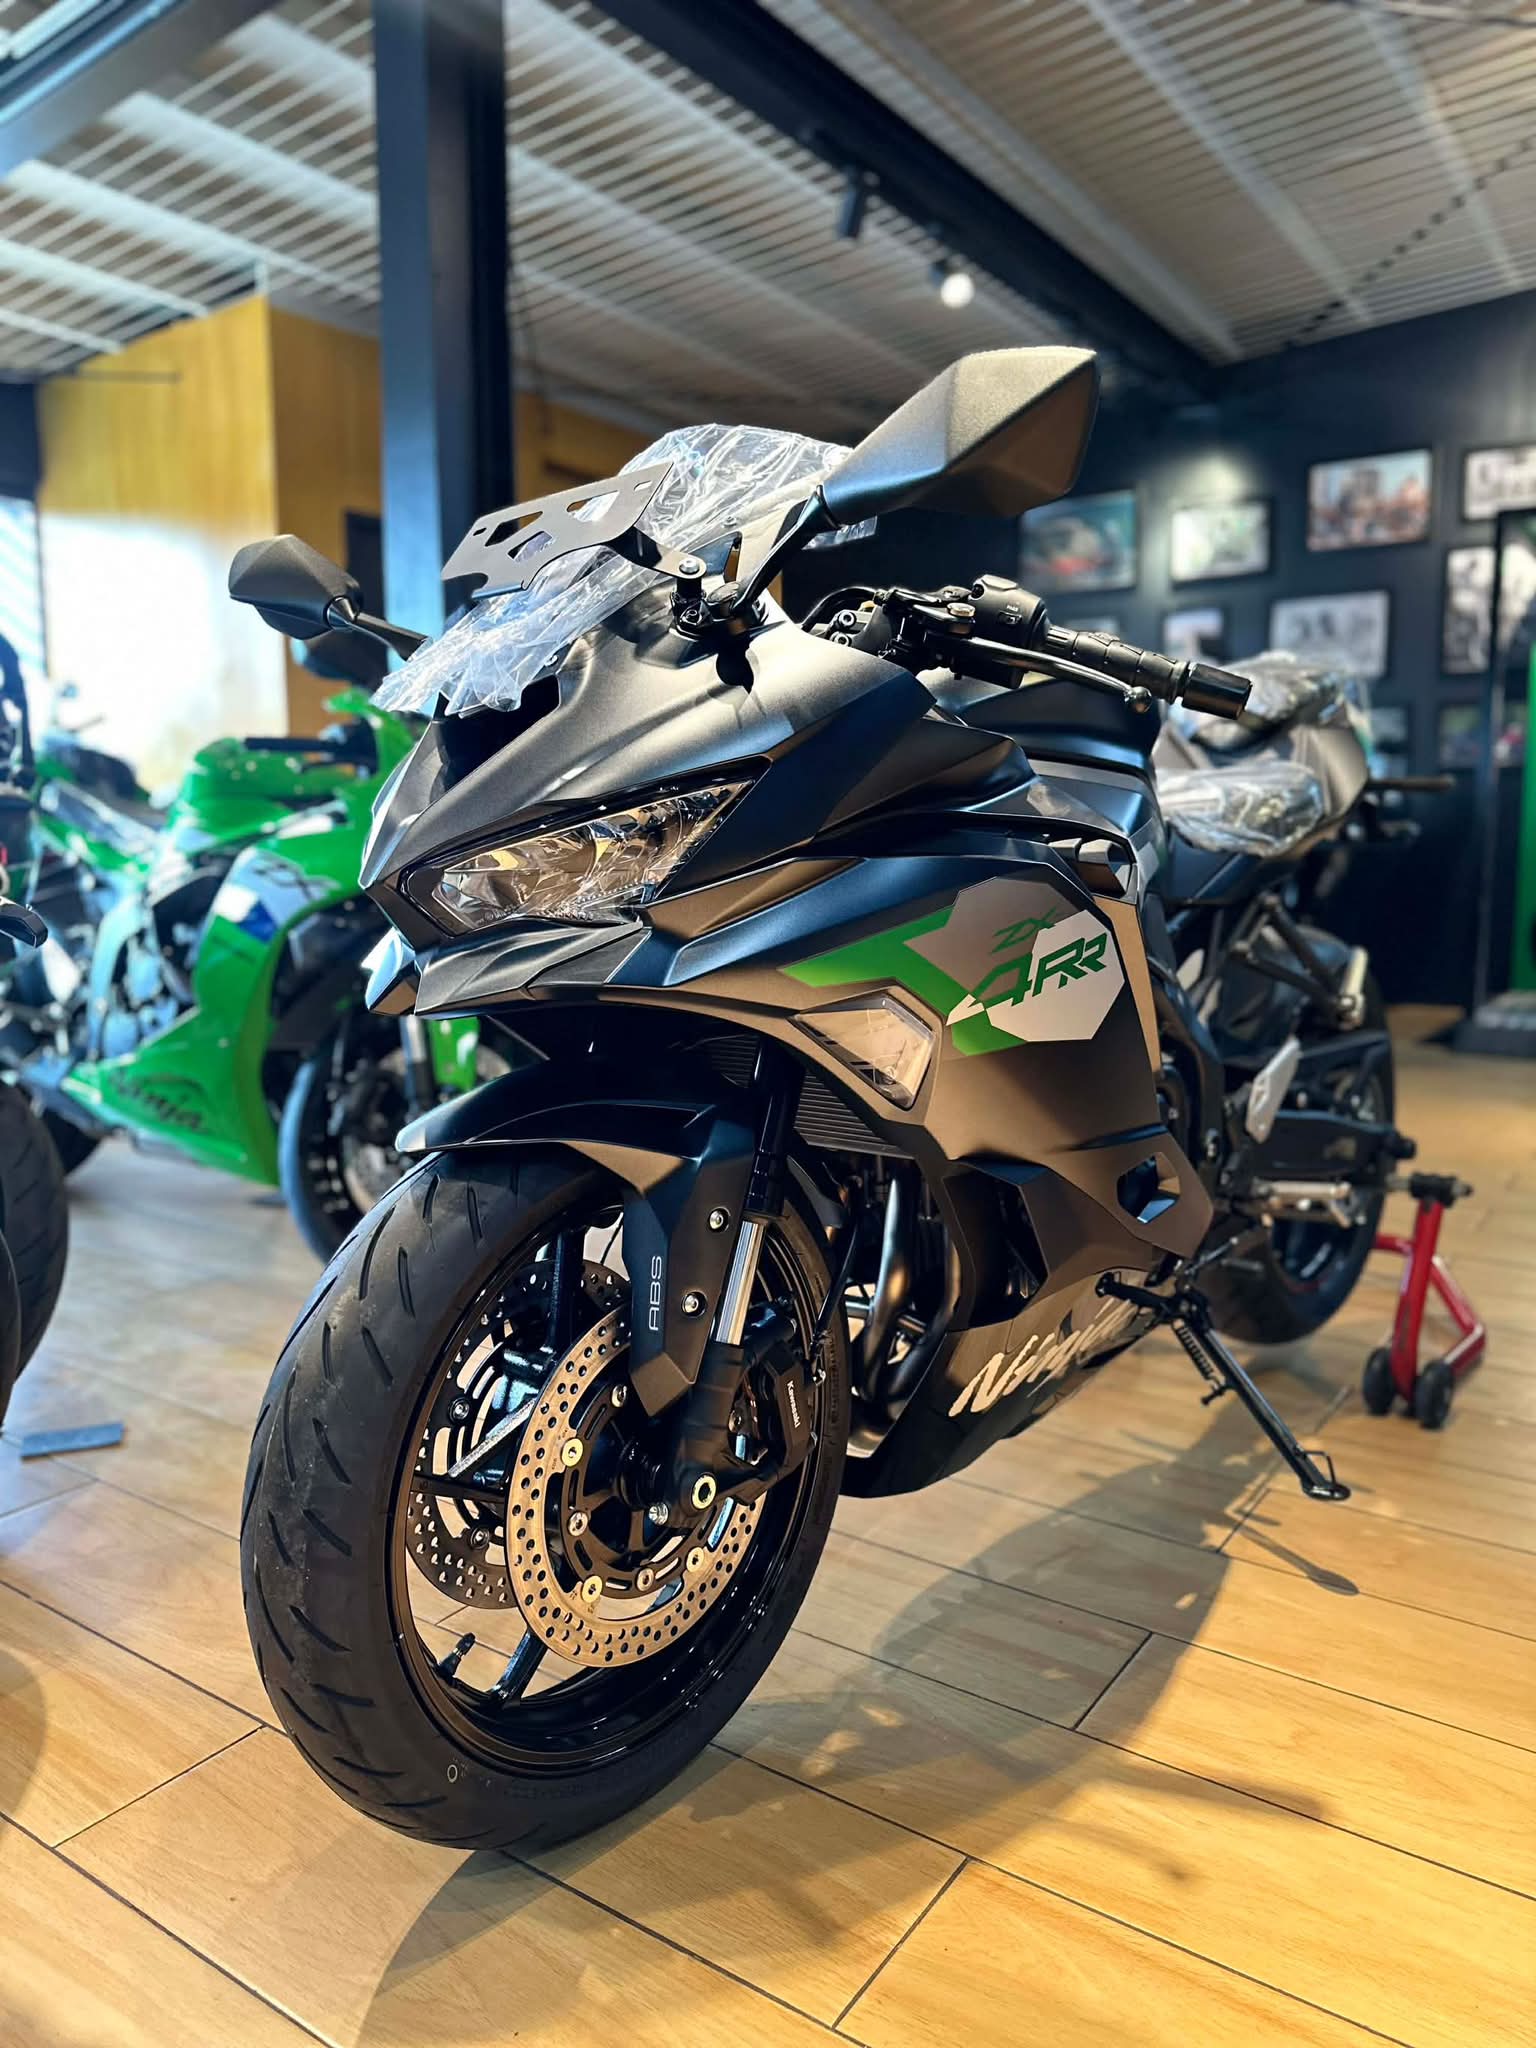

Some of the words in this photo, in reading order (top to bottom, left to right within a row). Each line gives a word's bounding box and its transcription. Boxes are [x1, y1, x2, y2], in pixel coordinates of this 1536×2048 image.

[991, 906, 1059, 955] ZX
[947, 932, 1108, 1026] 4RR
[649, 1255, 662, 1331] ABS
[948, 1297, 1139, 1418] Ninja
[787, 1380, 801, 1428] Kawasaki
